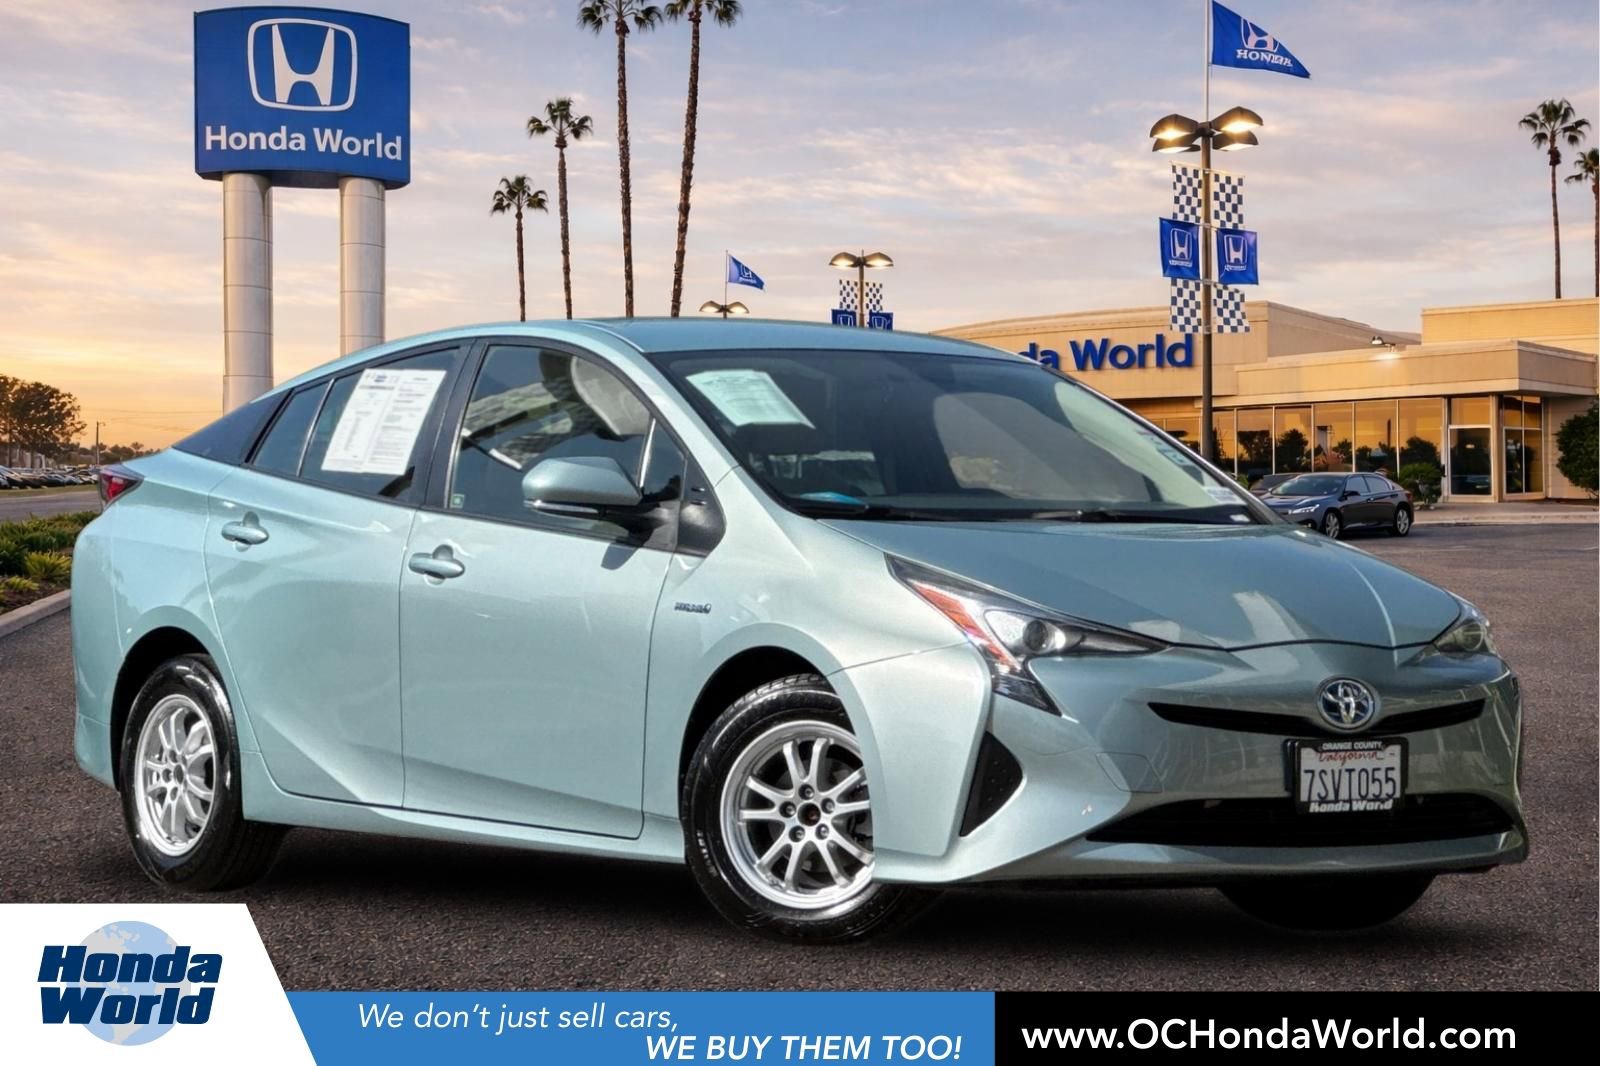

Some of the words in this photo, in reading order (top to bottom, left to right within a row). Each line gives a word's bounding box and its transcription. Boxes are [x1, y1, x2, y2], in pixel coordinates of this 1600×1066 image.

[205, 125, 306, 151] Honda
[313, 127, 402, 161] World
[1069, 333, 1194, 371] World
[1353, 741, 1383, 750] COUNTY
[1303, 767, 1396, 803] 7SVT055
[1309, 801, 1350, 813] Honda
